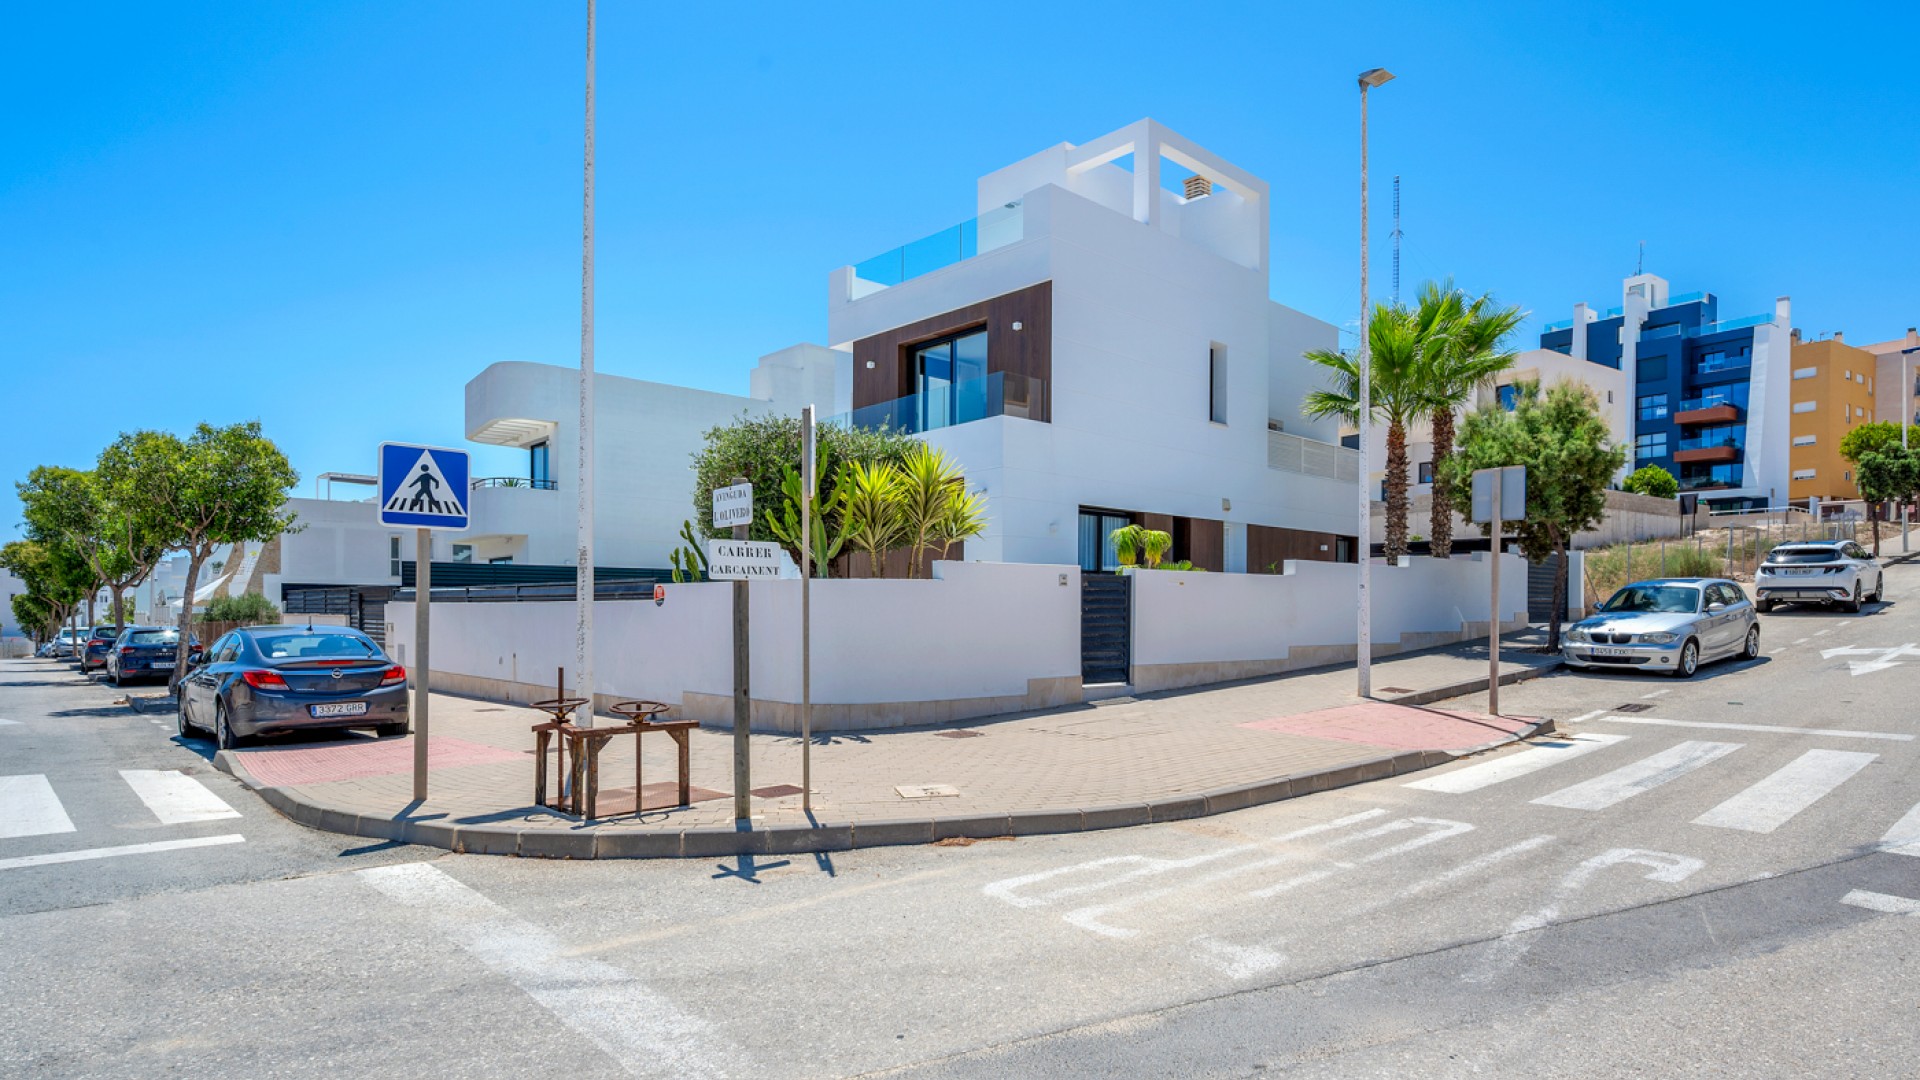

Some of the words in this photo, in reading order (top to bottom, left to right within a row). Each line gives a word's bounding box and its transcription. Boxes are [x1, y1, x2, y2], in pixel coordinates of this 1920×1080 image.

[718, 545, 772, 558] CARRER
[710, 564, 780, 576] CARCAIXENT
[318, 704, 344, 714] 3372
